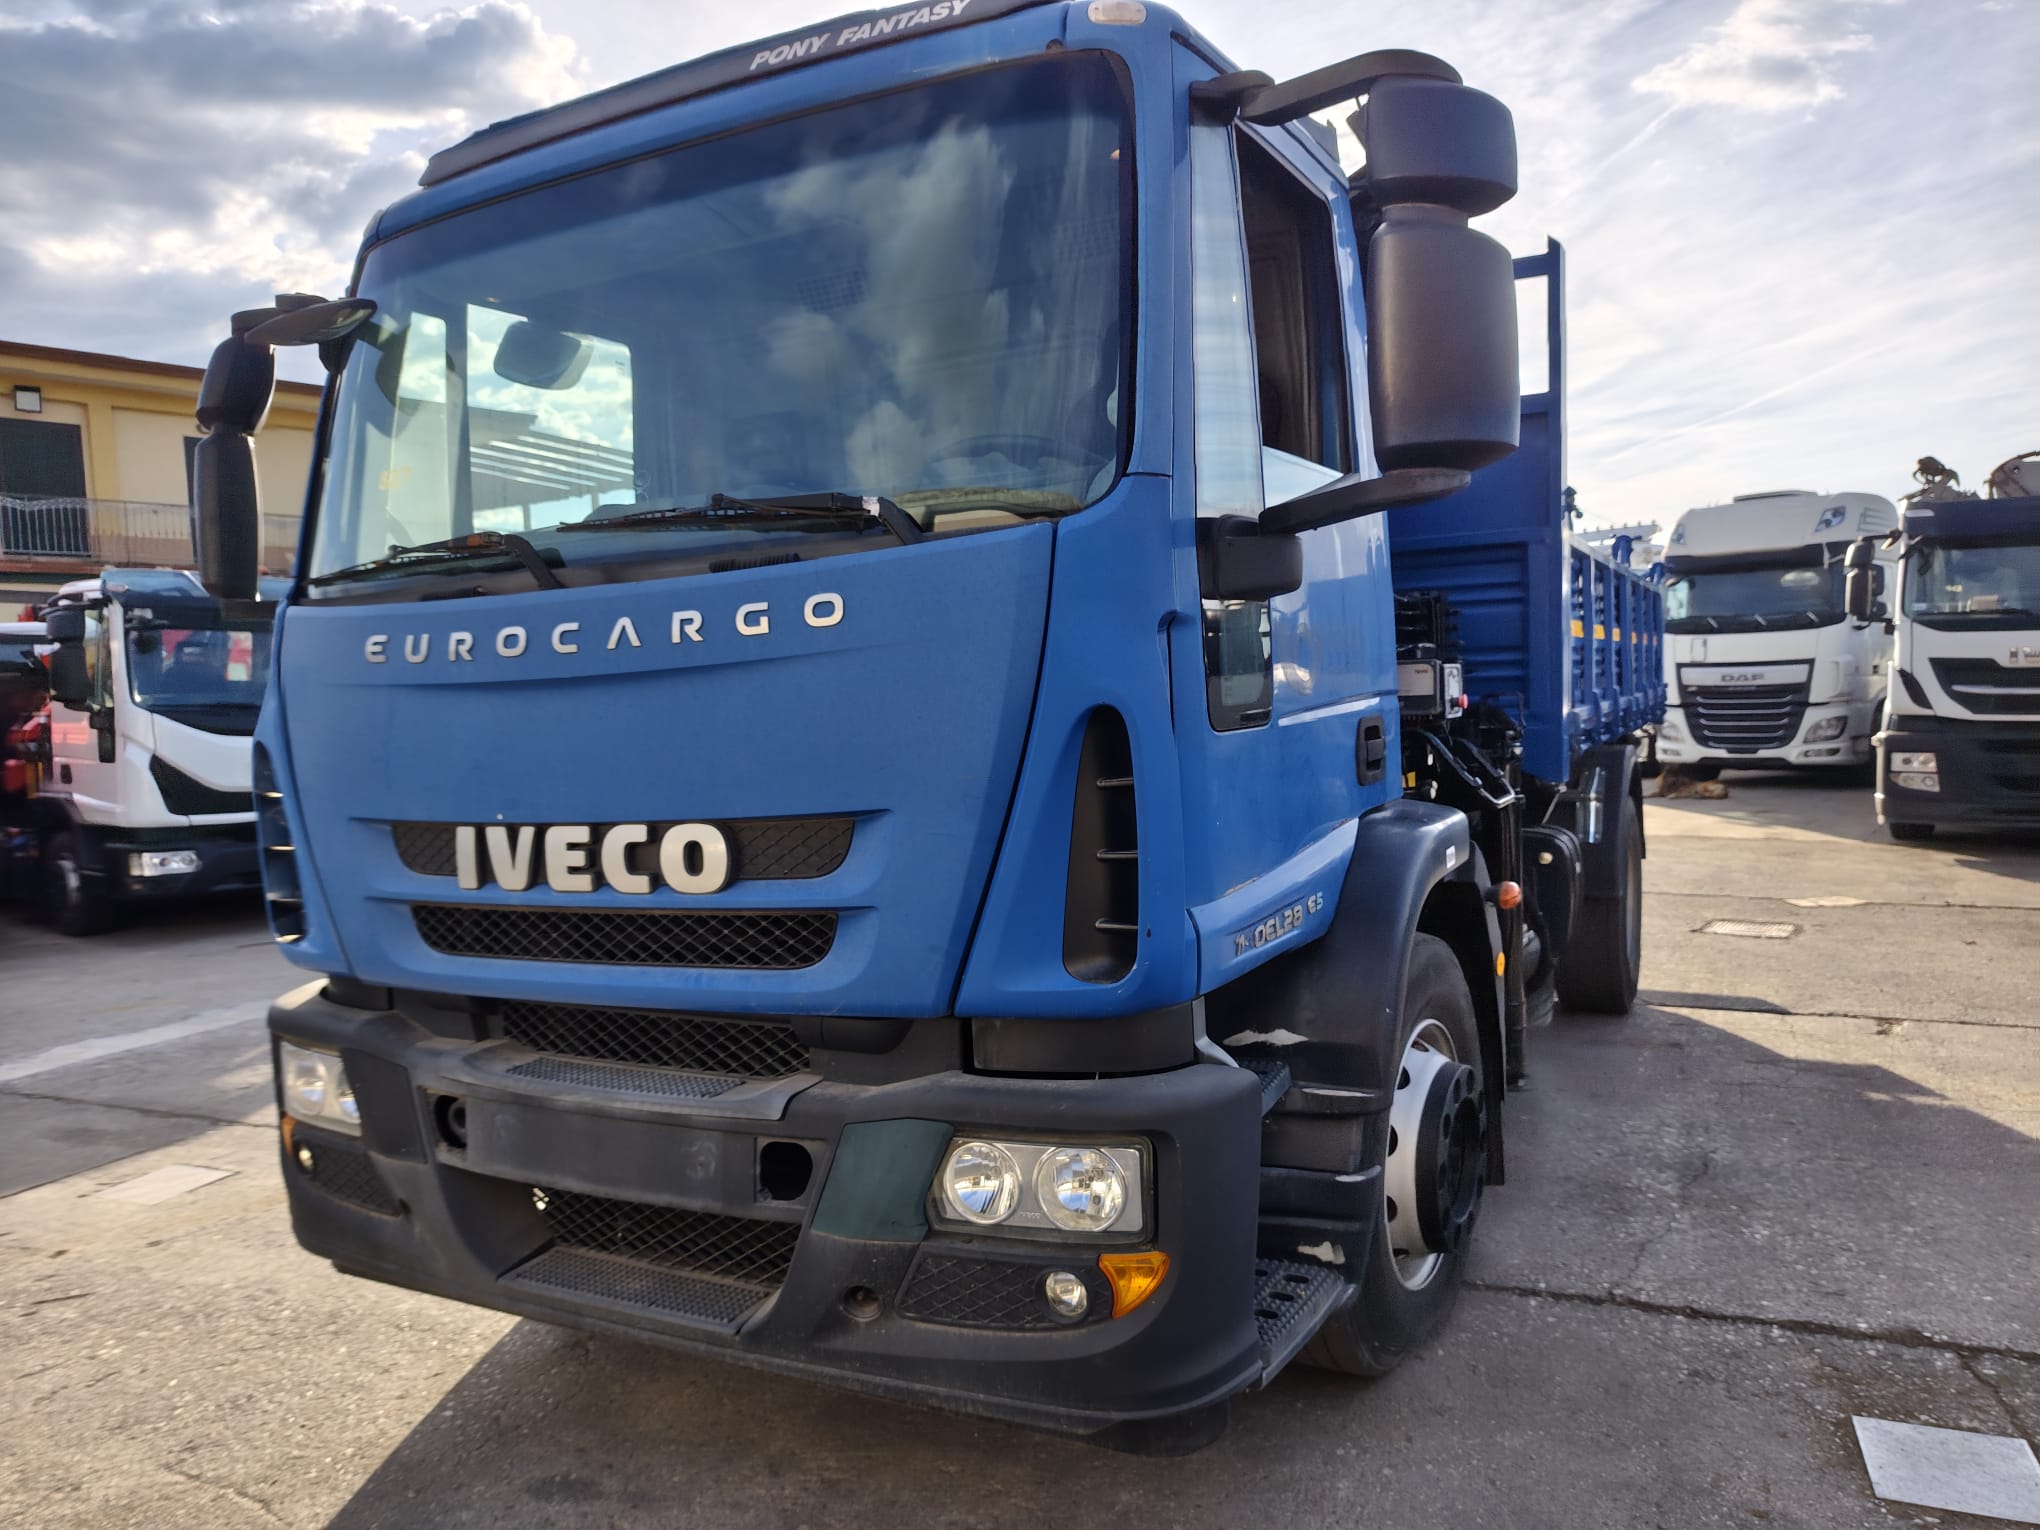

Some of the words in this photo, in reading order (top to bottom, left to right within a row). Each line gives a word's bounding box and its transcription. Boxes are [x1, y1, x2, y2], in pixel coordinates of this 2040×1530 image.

[750, 33, 831, 71] PONY
[836, 0, 971, 46] FANTASY
[365, 592, 845, 664] EUROCARGO
[1721, 673, 1765, 682] DAF
[455, 823, 730, 895] IVECO
